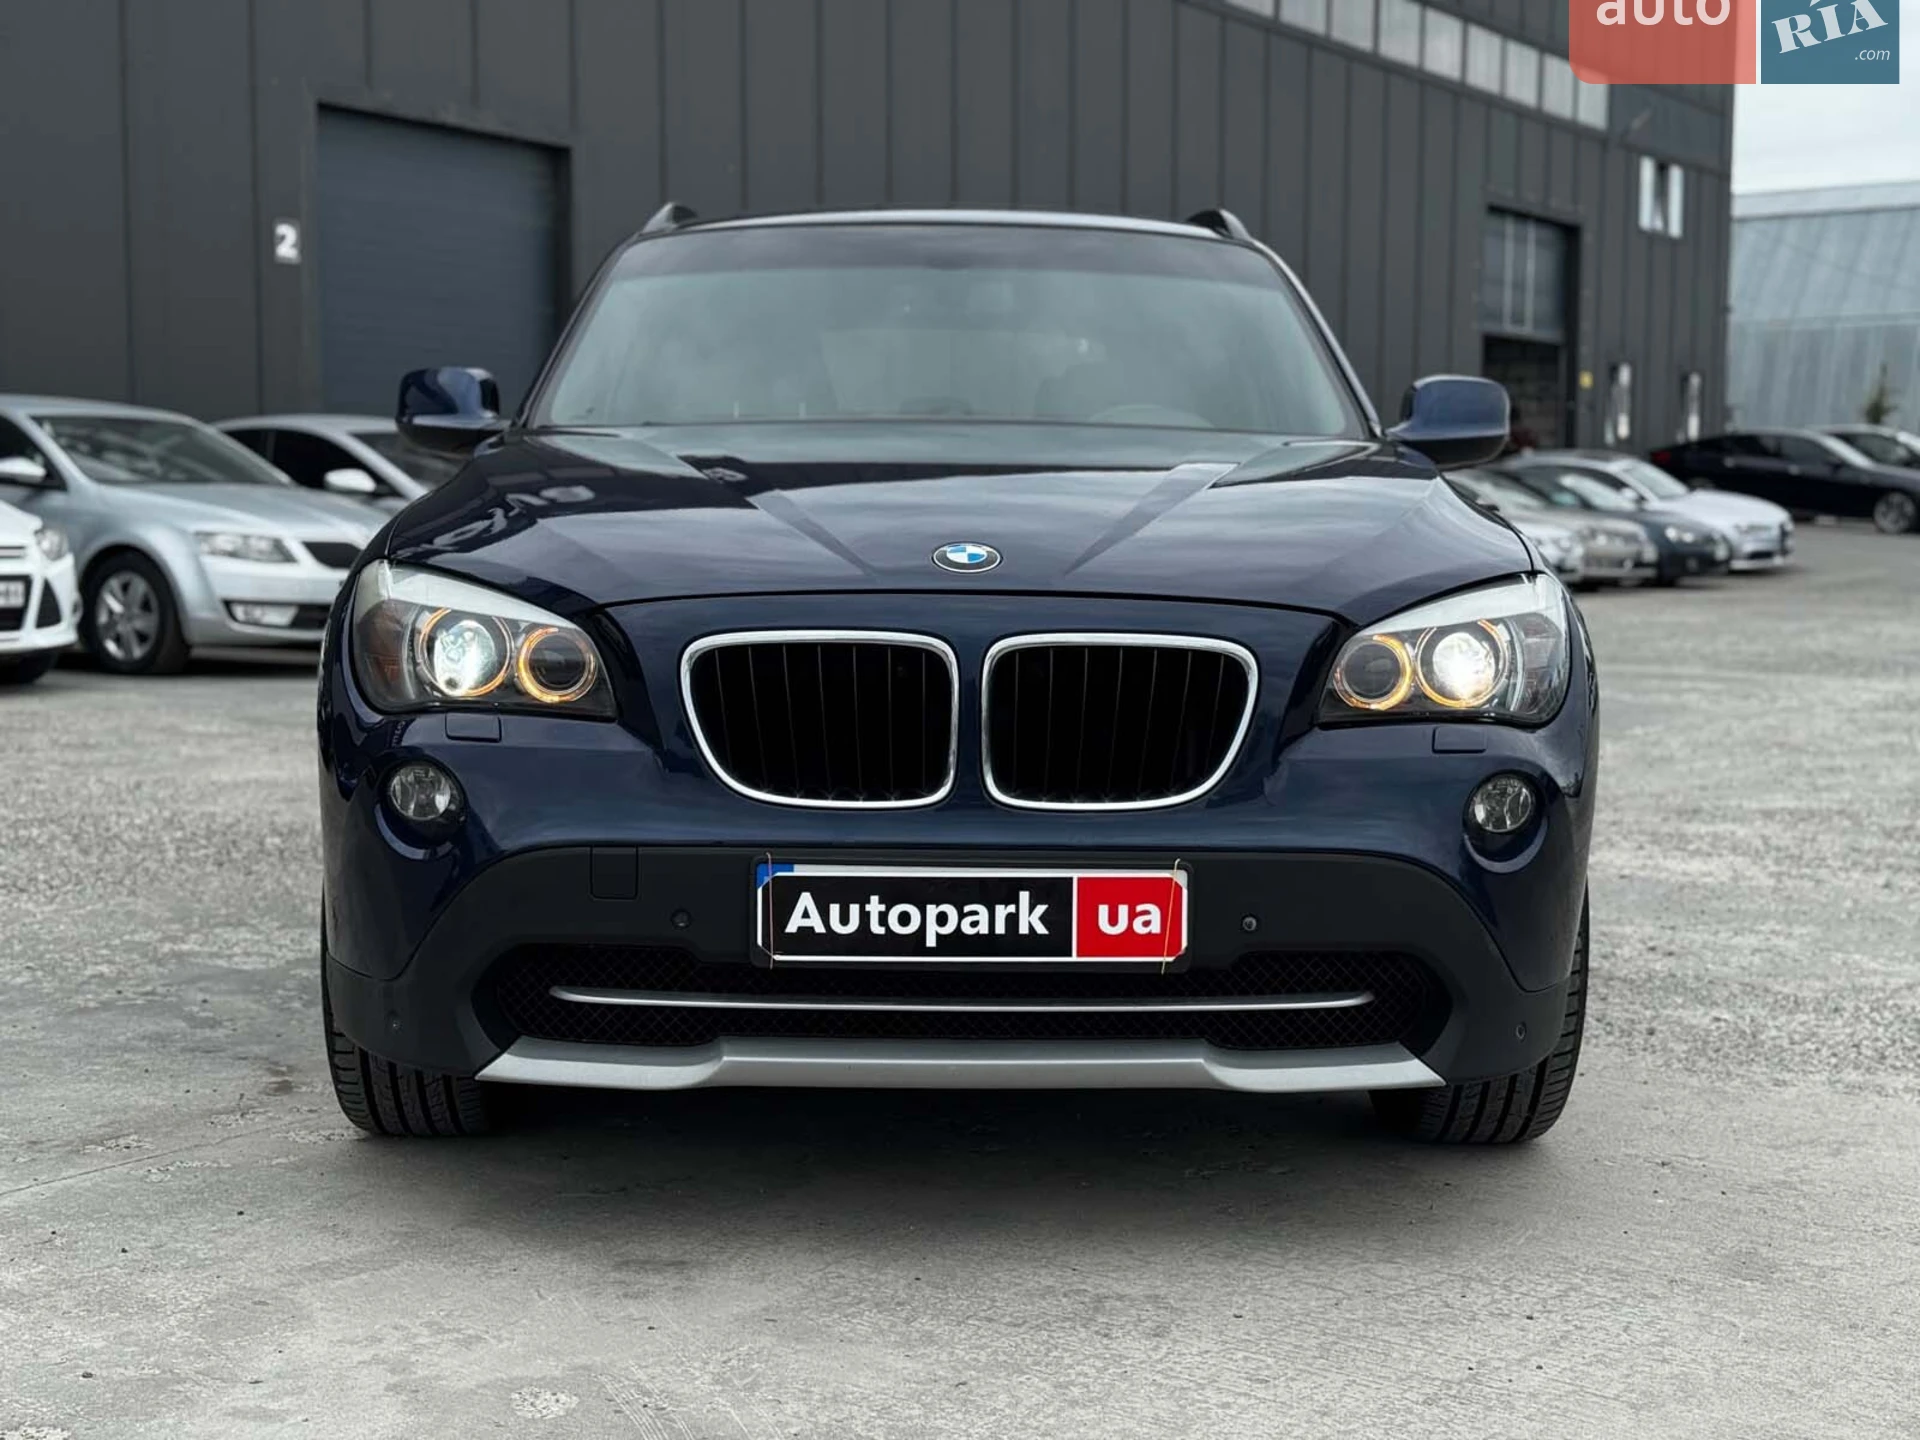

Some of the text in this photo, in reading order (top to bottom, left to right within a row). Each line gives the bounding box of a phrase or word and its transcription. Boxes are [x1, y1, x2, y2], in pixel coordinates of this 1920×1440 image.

[275, 223, 298, 259] 2
[784, 890, 1162, 948] Autopark ua
